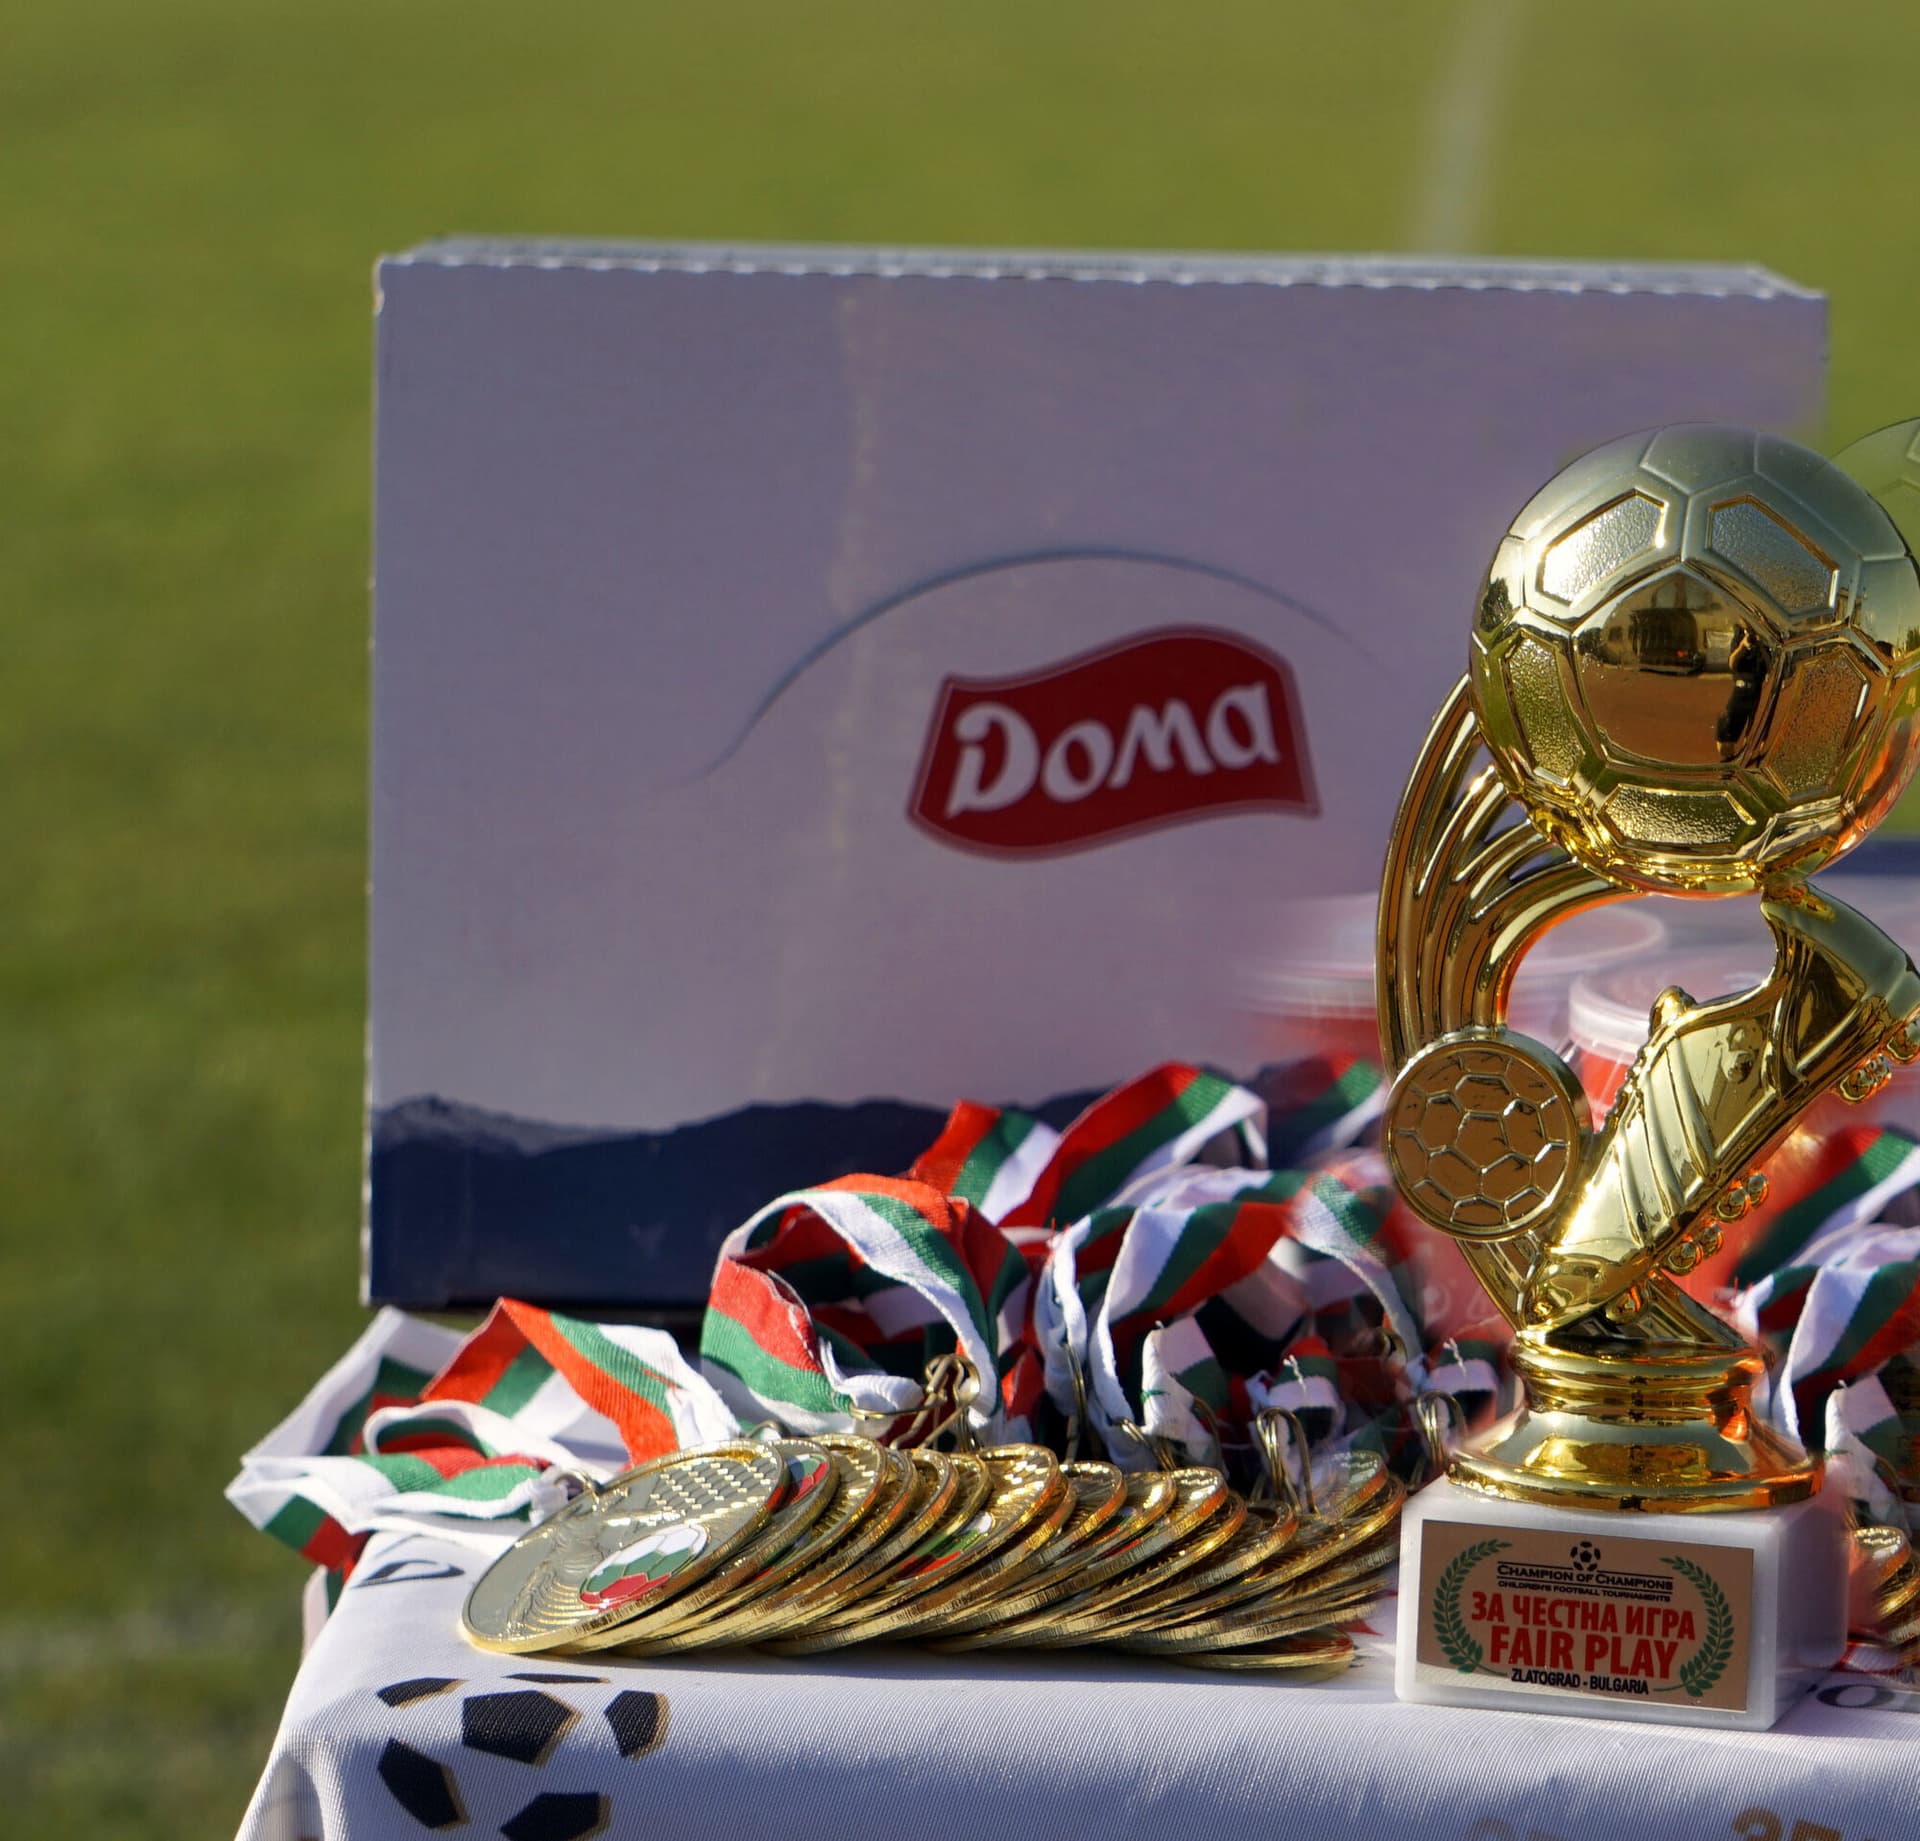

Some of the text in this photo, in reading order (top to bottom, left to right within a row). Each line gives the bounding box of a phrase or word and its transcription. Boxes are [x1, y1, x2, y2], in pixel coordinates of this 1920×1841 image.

[1553, 1586, 1600, 1597] FOOTBALL
[1603, 1590, 1671, 1602] TOURNAMENTS
[1471, 1591, 1696, 1641] ЗА ЧЕСТНА ИГРА
[1490, 1625, 1679, 1680] FAIR PLAY
[1511, 1668, 1581, 1689] ZLATOGRAD
[1589, 1675, 1649, 1695] BULGARIA
